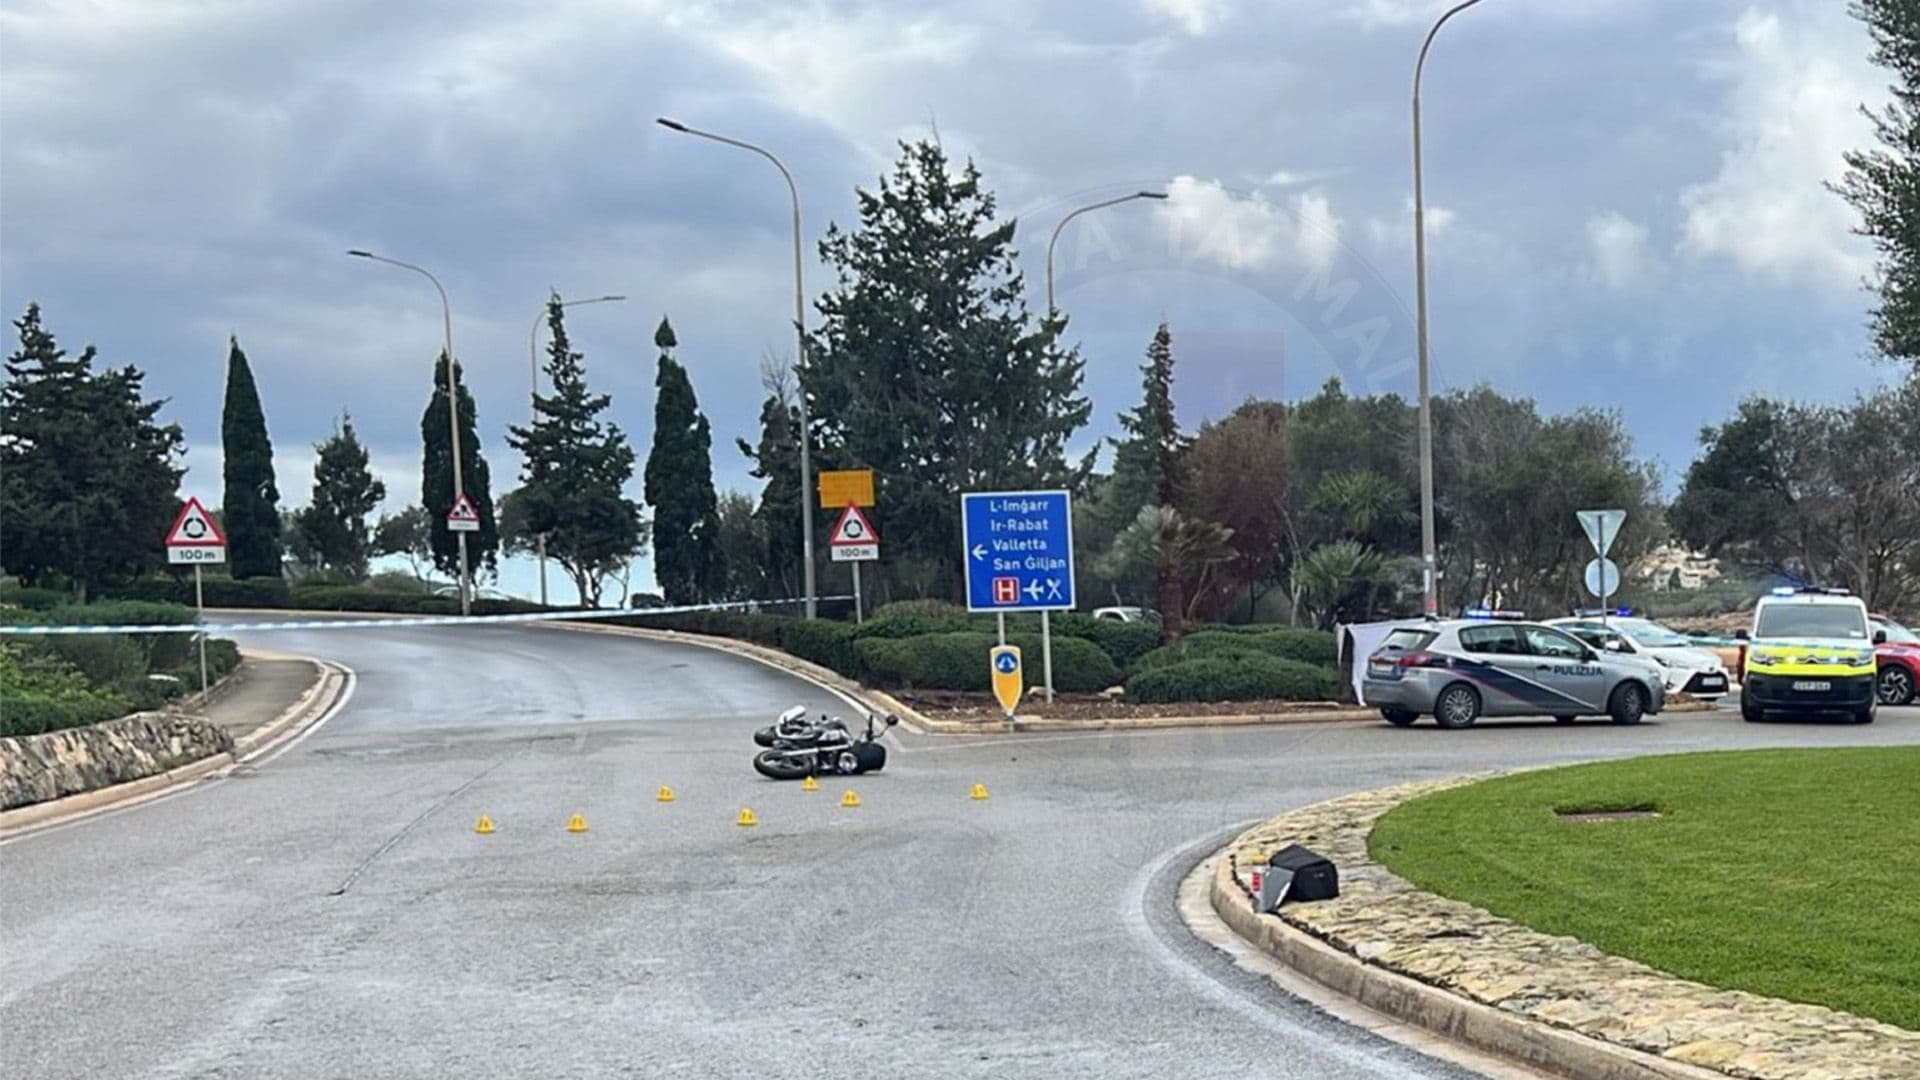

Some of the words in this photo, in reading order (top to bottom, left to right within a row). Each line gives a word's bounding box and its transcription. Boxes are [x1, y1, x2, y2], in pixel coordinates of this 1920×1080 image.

[990, 499, 1048, 514] L-Imġarr
[991, 519, 1048, 532] Ir-Rabat
[992, 539, 1047, 551] Valletta
[993, 558, 1020, 571] San
[1024, 555, 1066, 571] Ġiljan
[998, 580, 1014, 600] H
[1554, 665, 1603, 676] PULIZIJA
